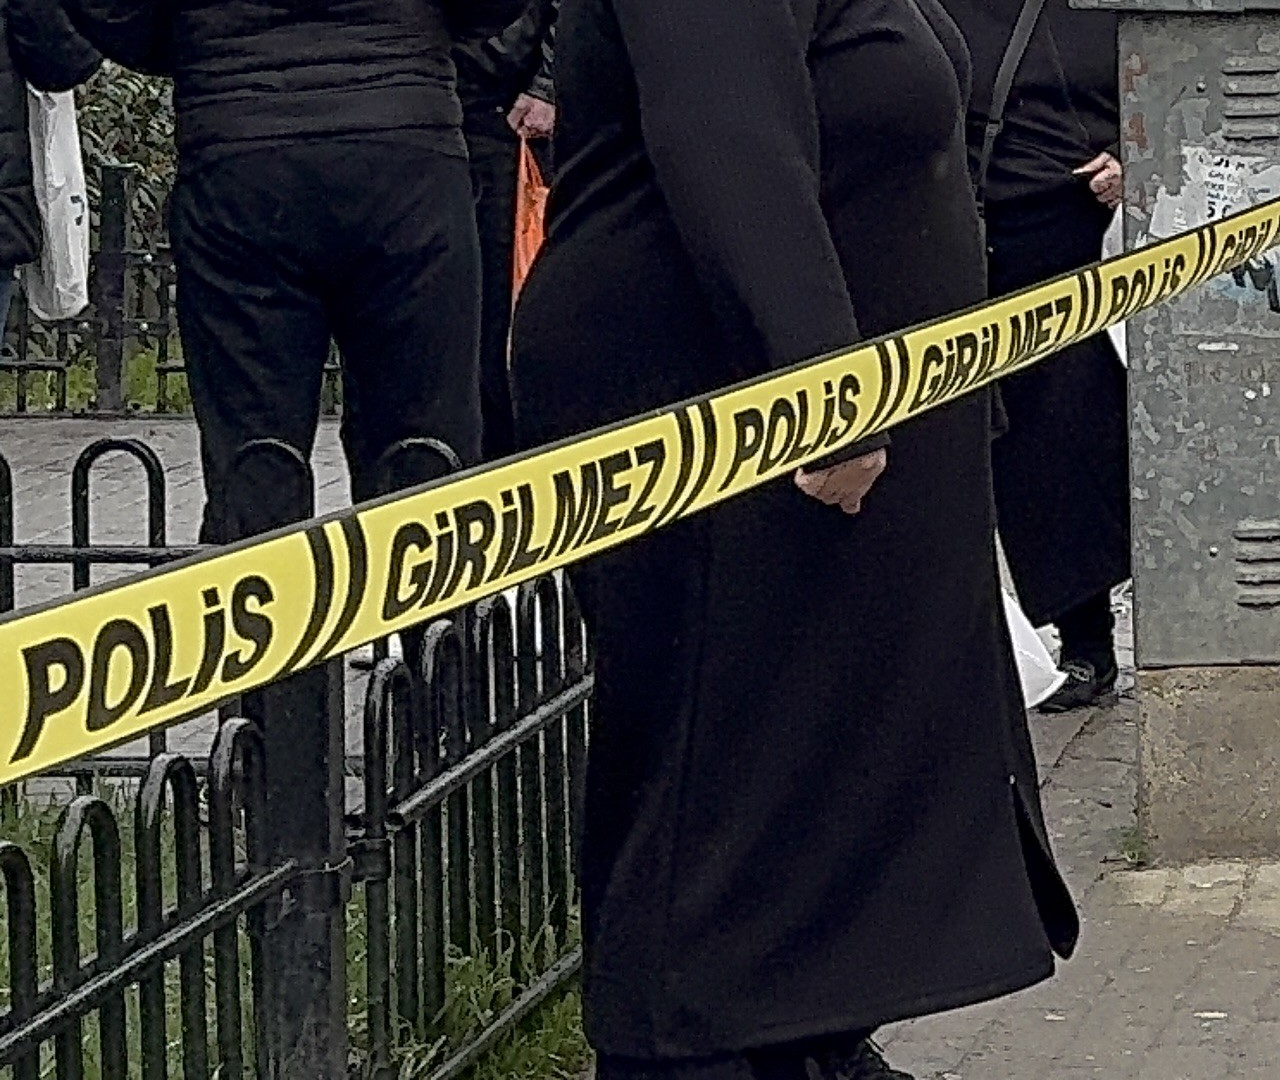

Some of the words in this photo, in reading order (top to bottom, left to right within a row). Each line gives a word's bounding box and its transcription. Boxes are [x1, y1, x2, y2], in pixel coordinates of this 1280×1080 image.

[9, 575, 275, 765] POLİS
[380, 437, 668, 622] GİRİLMEZ
[721, 371, 861, 490] POLİS
[907, 295, 1073, 415] GİRİLMEZ
[1107, 256, 1186, 323] POLİS
